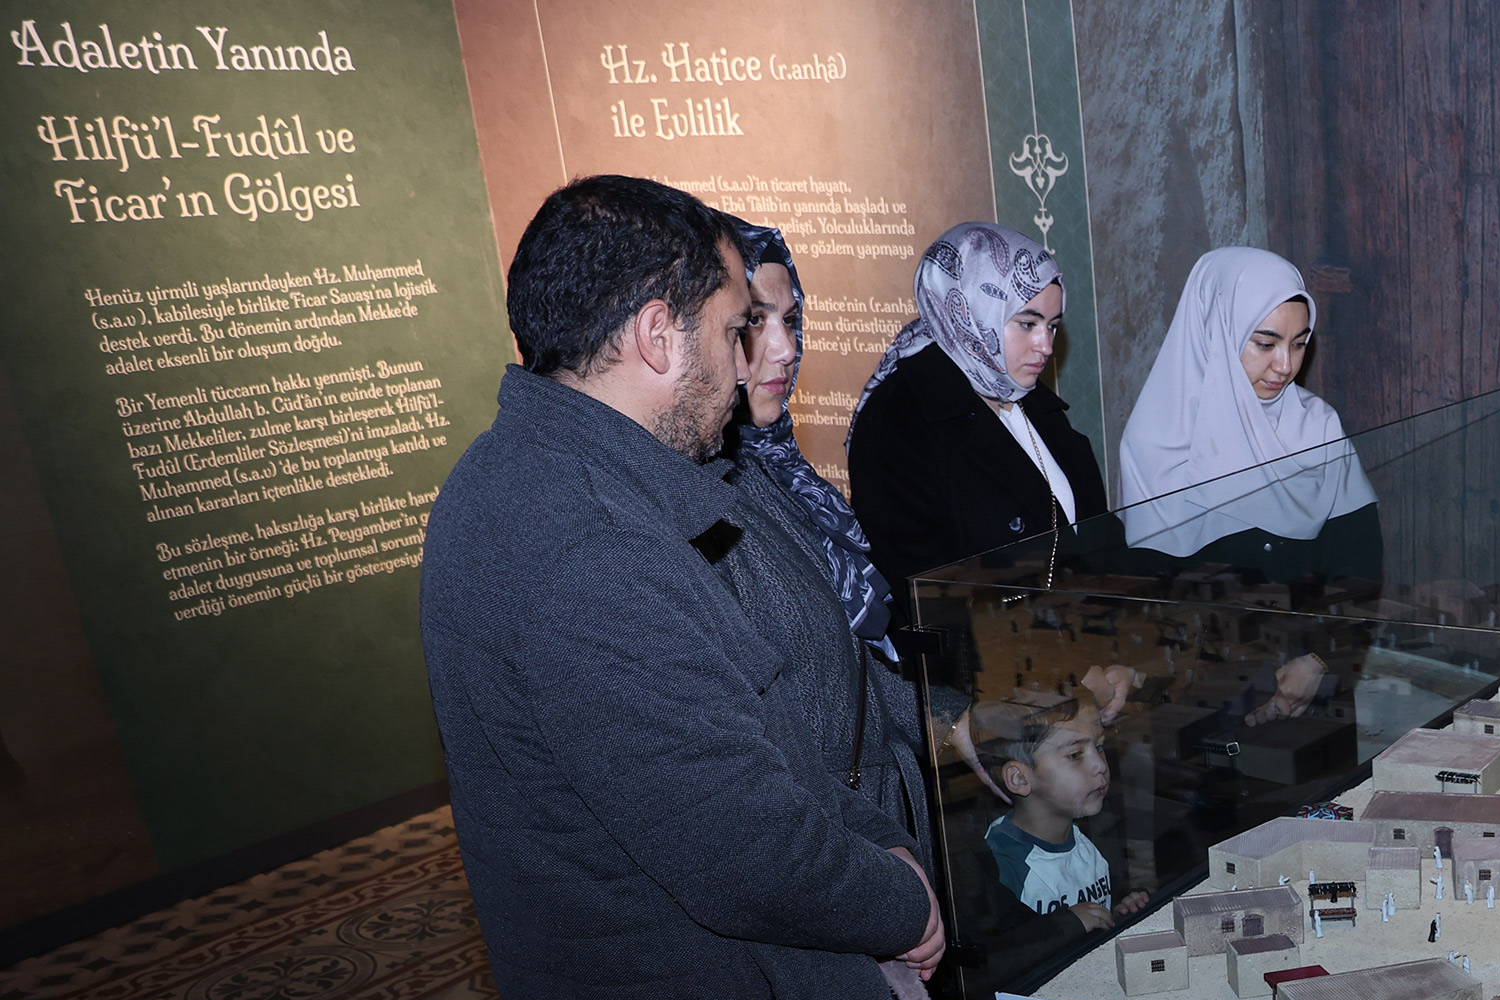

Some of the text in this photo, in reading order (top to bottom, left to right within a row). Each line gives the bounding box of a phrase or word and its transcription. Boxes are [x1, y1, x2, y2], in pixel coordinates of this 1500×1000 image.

[11, 19, 356, 75] Adaletin Yanında
[600, 42, 847, 86] Hz. Hatice (r.anhâ)
[37, 114, 357, 172] Hilfü'l-Fudûl ve
[611, 98, 744, 141] ile Evlilik
[54, 172, 360, 225] Ficar'ın Gölgesi
[645, 174, 717, 193] hammed
[771, 178, 809, 194] ticaret
[810, 177, 852, 196] hayatı,
[720, 195, 747, 214] Ebû
[793, 200, 842, 218] yanında
[845, 197, 889, 217] başladı
[892, 203, 907, 214] ve
[779, 217, 817, 238] gelişti.
[817, 217, 916, 236] Yolculuklarında
[795, 243, 810, 254] ve
[811, 239, 856, 259] gözlem
[857, 244, 915, 259] yapmaya
[84, 259, 425, 307] Henüz yirmili yaşlarındayken Hz. Muhammed
[153, 300, 236, 322] kabilesiyle
[237, 294, 290, 315] birlikte
[289, 291, 328, 309] Ficar
[393, 278, 438, 300] lojistik
[805, 294, 868, 313] Hatice'nin
[99, 300, 419, 354] destek verdi. Bu dönemin ardından Mekke'de
[105, 331, 343, 376] adalet eksenli bir oluşum doğdu.
[853, 337, 894, 353] (r.anh
[116, 359, 425, 418] Bir Yemenli tüccarın hakkı yenmişti. Bunun
[122, 417, 182, 437] üzerine
[183, 402, 255, 428] Abdullah
[253, 400, 270, 416] b.
[339, 382, 384, 403] evinde
[385, 377, 442, 399] toplanan
[798, 389, 816, 405] bir
[818, 391, 859, 411] evliliğe
[126, 442, 163, 459] bazı
[164, 427, 247, 453] Mekkeliler,
[248, 420, 292, 439] zulme
[293, 415, 329, 432] karşı
[329, 400, 396, 424] birleşerek
[132, 456, 182, 480] Fudûl
[183, 444, 267, 472] (Erdemliler
[366, 415, 425, 439] imzaladı.
[424, 411, 451, 429] Hz.
[138, 470, 233, 501] Muhammed
[300, 455, 322, 473] bu
[322, 448, 389, 470] toplantıya
[389, 434, 431, 455] katıldı
[431, 434, 448, 448] ve
[146, 462, 394, 523] alınan kararları içtenlikle destekledi.
[155, 542, 183, 563] Bu
[184, 531, 255, 555] sözleşme,
[254, 514, 326, 539] haksızlığa
[325, 508, 360, 524] karşı
[360, 496, 407, 517] birlikte
[162, 511, 430, 581] etmenin bir örneği; Hz. Peygamber'in g
[168, 528, 427, 602] adalet duygusuna ve toplumsal soruml
[173, 596, 226, 622] verdiği
[228, 585, 282, 608] önemin
[283, 573, 323, 599] güçlü
[323, 569, 344, 586] bir
